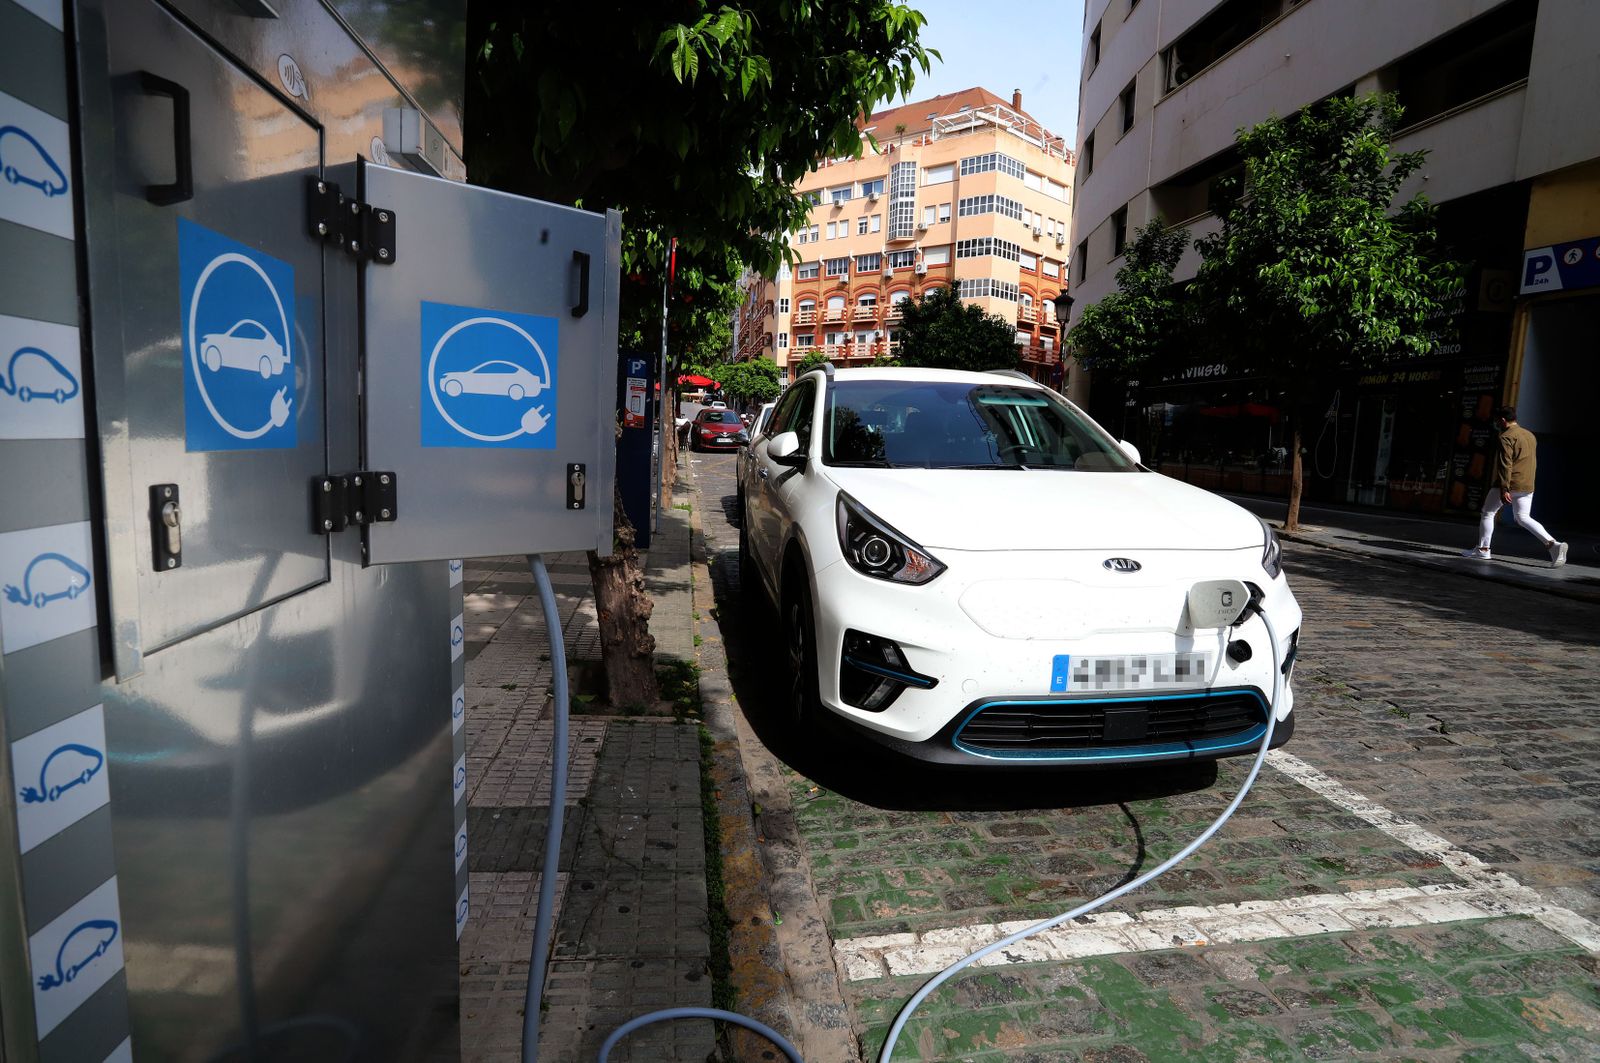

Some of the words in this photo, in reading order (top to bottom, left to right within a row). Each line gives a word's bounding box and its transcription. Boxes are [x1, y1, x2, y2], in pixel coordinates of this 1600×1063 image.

[1525, 255, 1552, 286] P
[1534, 278, 1549, 286] 24h
[631, 361, 643, 375] P
[1391, 371, 1407, 383] 24
[1107, 558, 1139, 570] KIA
[1056, 676, 1063, 684] E
